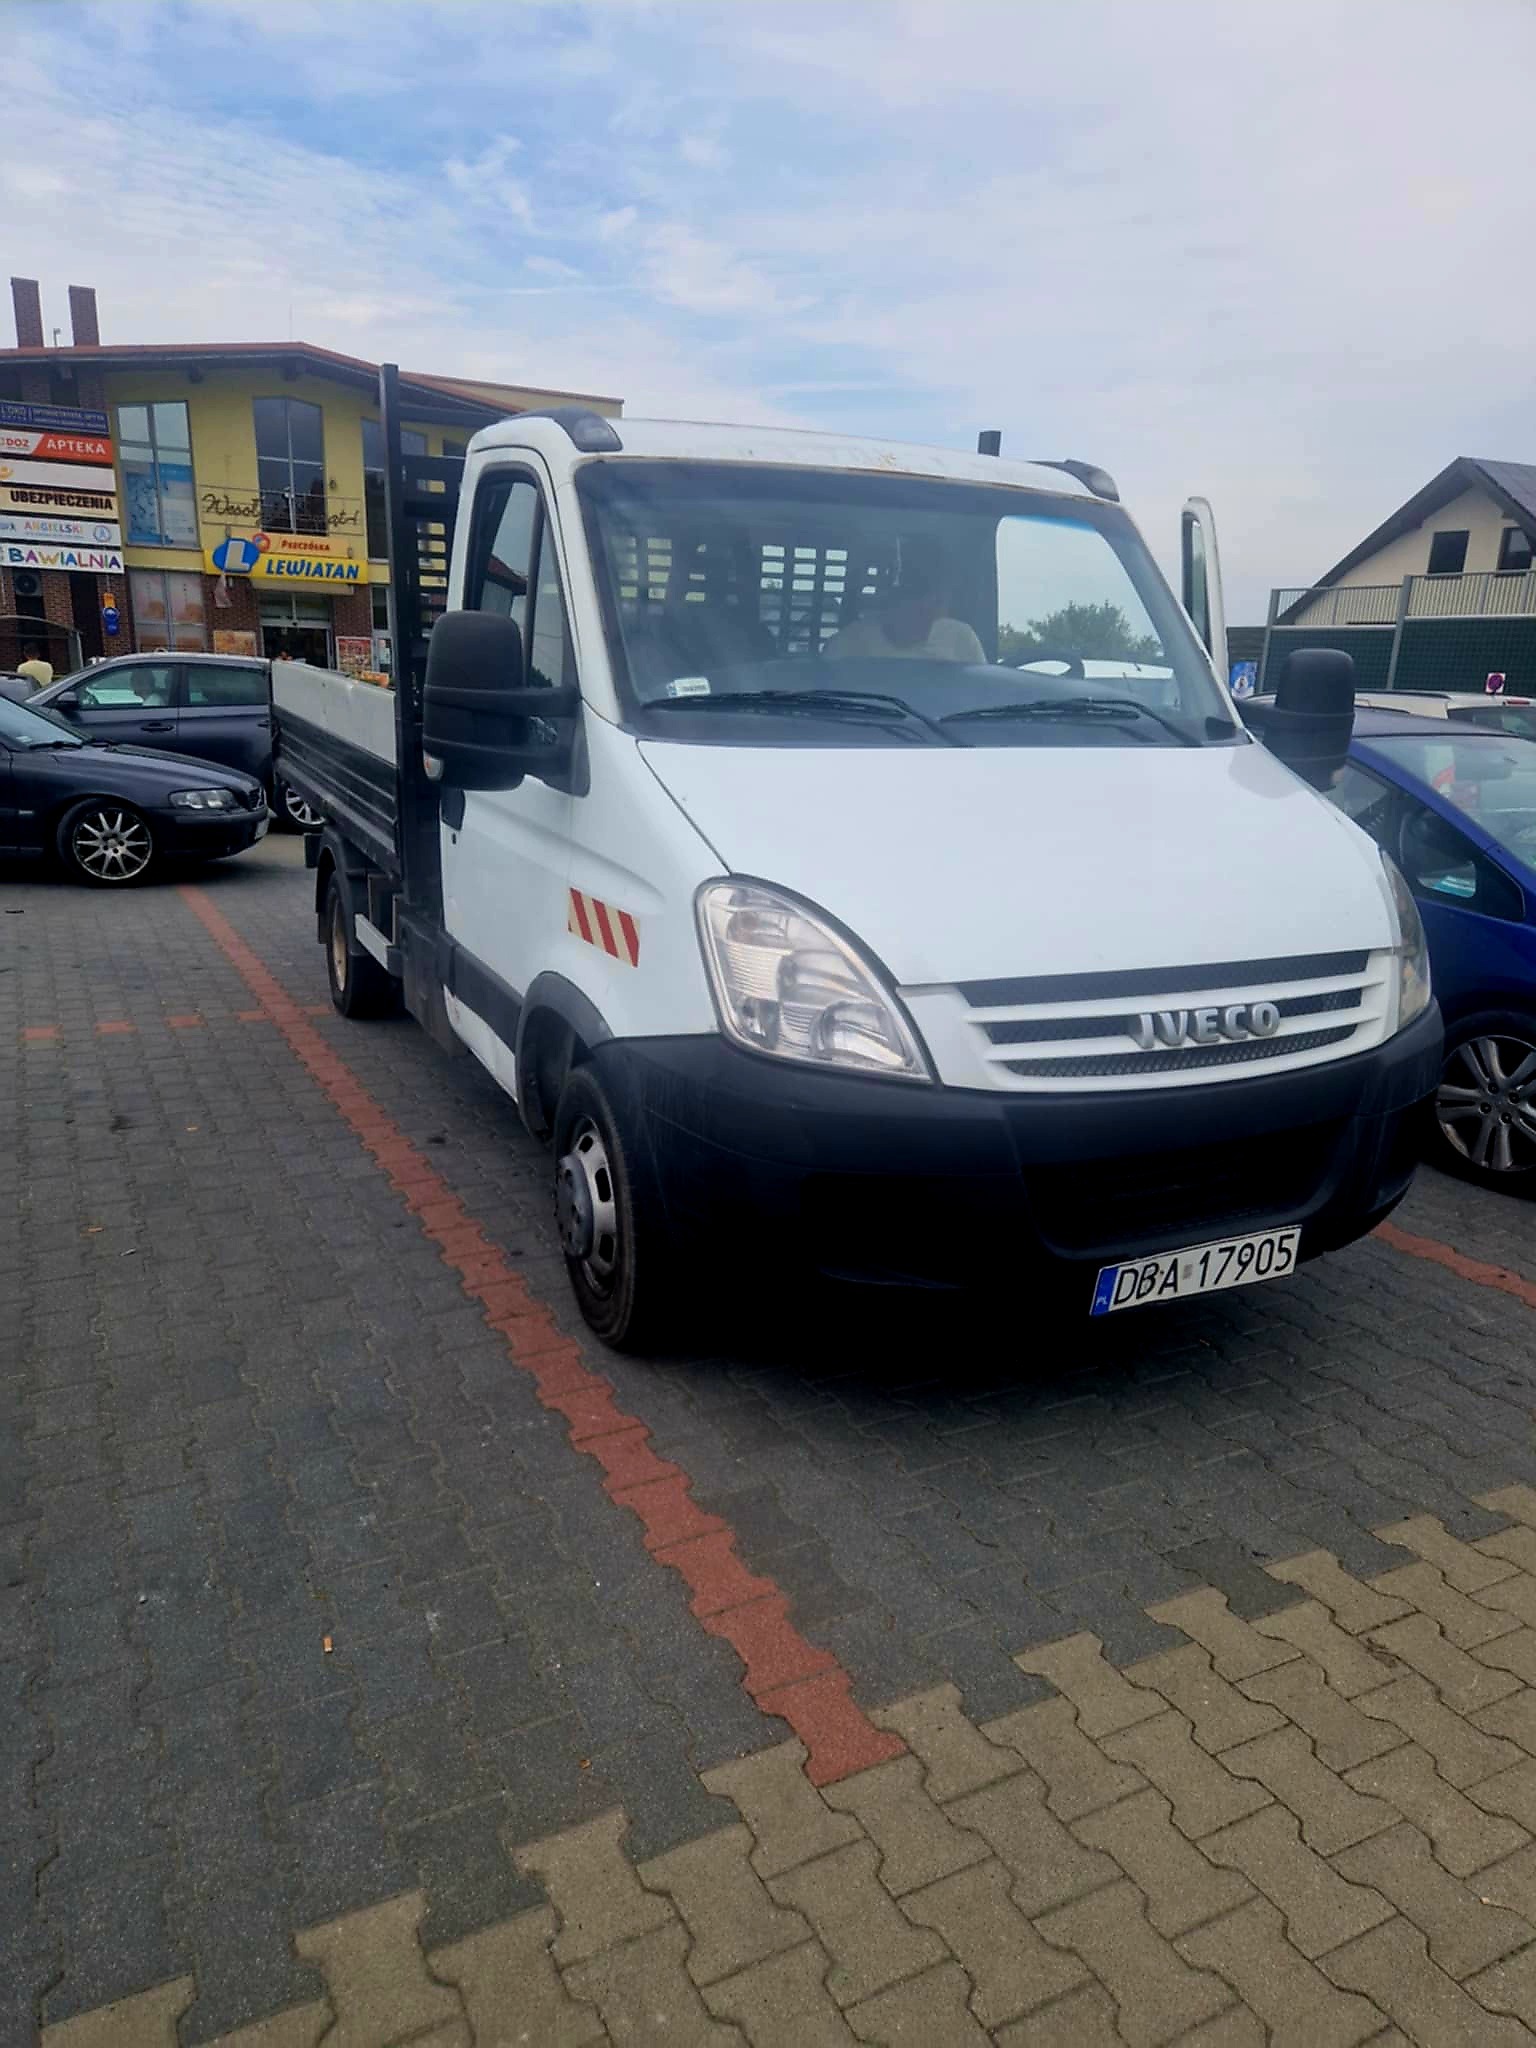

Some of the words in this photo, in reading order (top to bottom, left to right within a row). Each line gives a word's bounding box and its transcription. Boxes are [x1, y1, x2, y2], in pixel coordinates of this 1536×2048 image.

[47, 439, 107, 456] APTEKA
[10, 490, 113, 510] UBEZPIECZENIA
[8, 547, 121, 569] BAWIALNIA
[266, 558, 361, 580] LEWIATAN
[1134, 1002, 1280, 1049] IVECO
[1113, 1258, 1179, 1304] DBA
[1199, 1233, 1295, 1288] 17905
